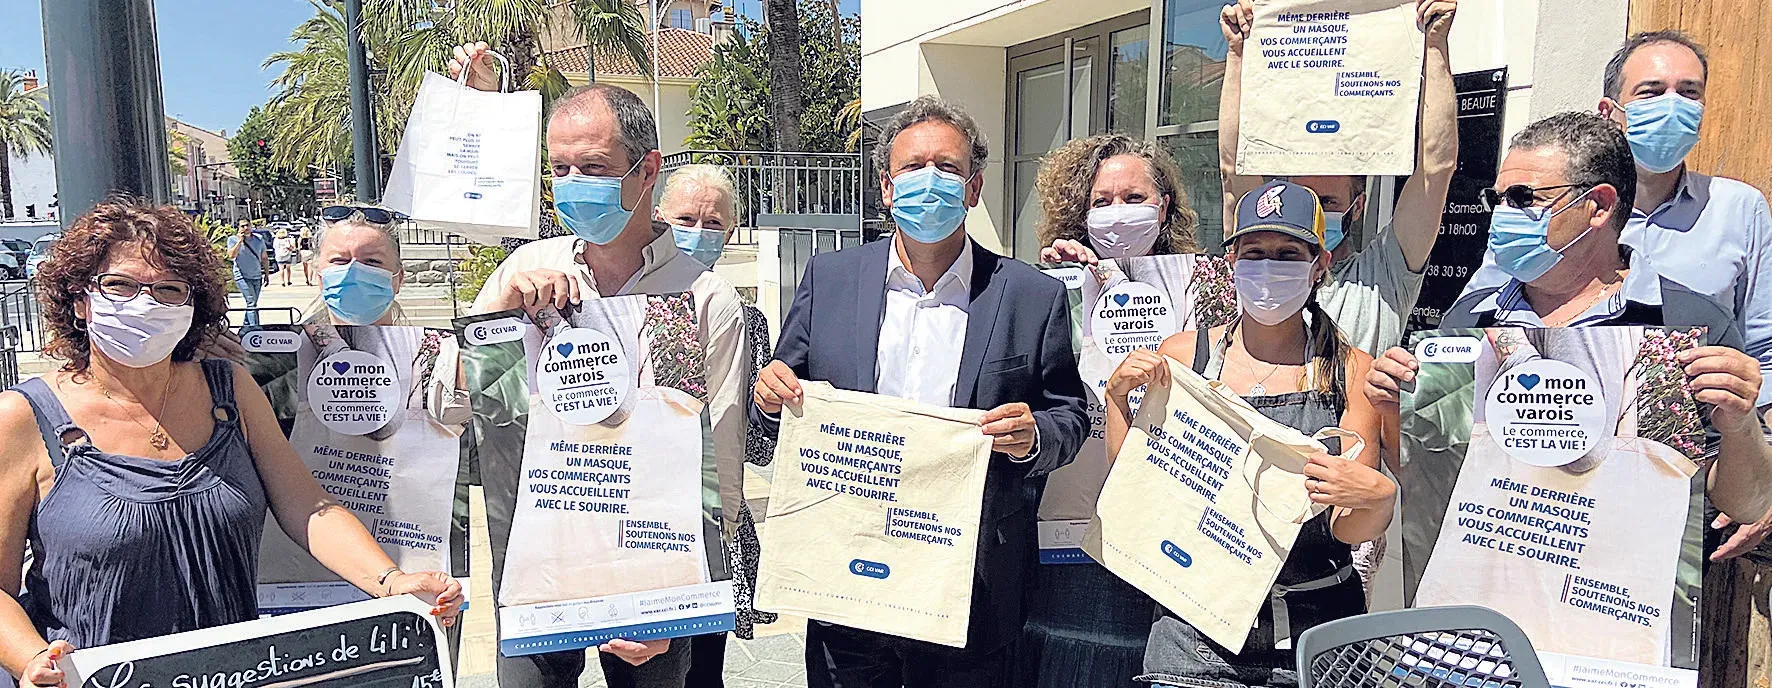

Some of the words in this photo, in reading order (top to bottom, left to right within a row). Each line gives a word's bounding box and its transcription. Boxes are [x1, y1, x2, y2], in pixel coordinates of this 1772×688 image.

[1277, 12, 1304, 22] MÊME
[1306, 10, 1350, 22] DERRIÈRE
[1293, 25, 1306, 34] UN
[1308, 23, 1349, 34] MASQUE,
[1260, 37, 1278, 46] VOS
[1279, 35, 1348, 47] COMMERÇANTS
[1262, 49, 1286, 58] VOUS
[1287, 47, 1347, 57] ACCUEILLENT
[1267, 61, 1289, 69] AVEC
[1290, 60, 1301, 69] LE
[1303, 59, 1345, 68] SOURIRE.
[1341, 71, 1381, 79] ENSEMBLE,
[1340, 80, 1384, 88] SOUTENONS
[1385, 79, 1401, 87] NOS
[1339, 89, 1395, 98] COMMERÇANTS.
[1461, 95, 1497, 111] BEAUTE
[1448, 223, 1477, 235] 18h00
[1427, 265, 1439, 276] 38
[1441, 265, 1454, 277] 30
[1455, 266, 1468, 278] 39
[1133, 295, 1161, 305] mon
[1099, 306, 1167, 319] commerce
[491, 327, 503, 335] CCI
[504, 325, 518, 333] VAR
[1113, 317, 1154, 331] varois
[577, 341, 610, 355] mon
[1104, 336, 1116, 345] Le
[354, 364, 385, 374] mon
[544, 353, 618, 373] commerce
[316, 376, 392, 386] commerce
[560, 367, 605, 386] varois
[1545, 377, 1586, 390] mon
[331, 388, 377, 399] varois
[552, 393, 563, 402] Le
[565, 387, 618, 401] commerce,
[1496, 391, 1594, 405] commerce
[321, 404, 332, 412] Le
[335, 404, 388, 413] commerce,
[555, 402, 580, 413] C'EST
[583, 399, 595, 409] LA
[596, 398, 613, 407] VIE
[1515, 405, 1574, 421] varois
[323, 413, 350, 421] C'EST
[352, 413, 366, 421] LA
[367, 413, 381, 421] VIE
[819, 423, 851, 438] MÊME
[853, 429, 906, 446] DERRIÈRE
[1173, 409, 1197, 430] MÊME
[1198, 424, 1243, 456] DERRIÈRE
[1503, 426, 1516, 436] Le
[1520, 427, 1588, 440] commerce,
[550, 440, 579, 453] MÊME
[581, 443, 633, 456] DERRIÈRE
[837, 441, 852, 453] UN
[854, 444, 903, 462] MASQUE,
[1182, 430, 1196, 444] UN
[1195, 438, 1233, 469] MASQUE,
[1504, 437, 1539, 449] C'EST
[1541, 439, 1557, 449] LA
[1559, 440, 1579, 450] VIE
[313, 445, 344, 458] MÊME
[345, 451, 395, 467] DERRIÈRE
[1148, 424, 1168, 440] VOS
[1167, 435, 1230, 481] COMMERÇANTS
[566, 457, 581, 467] UN
[583, 458, 632, 471] MASQUE,
[799, 447, 821, 460] VOS
[822, 452, 901, 475] COMMERÇANTS
[1146, 438, 1171, 457] VOUS
[1170, 452, 1225, 492] ACCUEILLENT
[328, 460, 345, 470] UN
[345, 463, 392, 479] MASQUE,
[528, 469, 549, 479] VOS
[550, 470, 631, 485] COMMERÇANTS
[800, 462, 830, 476] VOUS
[831, 468, 901, 488] ACCUEILLENT
[311, 469, 390, 490] COMMERÇANTS
[1146, 453, 1170, 472] AVEC
[1168, 468, 1179, 479] LE
[1179, 474, 1217, 505] SOURIRE.
[529, 483, 558, 495] VOUS
[559, 485, 631, 499] ACCUEILLENT
[806, 477, 833, 491] AVEC
[834, 482, 847, 493] LE
[848, 485, 898, 503] SOURIRE.
[1490, 477, 1529, 495] MÊME
[1530, 486, 1596, 509] DERRIÈRE
[338, 499, 385, 515] OURIRE.
[535, 499, 561, 510] AVEC
[563, 500, 576, 511] LE
[578, 501, 630, 514] SOURIRE.
[1509, 496, 1529, 510] UN
[1530, 501, 1592, 525] MASQUE,
[893, 507, 939, 523] ENSEMBLE,
[1208, 508, 1245, 538] ENSEMBLE,
[1458, 501, 1485, 515] VOS
[1486, 507, 1589, 539] COMMERÇANTS
[379, 519, 421, 532] ENSEMBLE,
[626, 519, 671, 531] ENSEMBLE,
[891, 518, 943, 533] SOUTENONS
[944, 527, 962, 537] NOS
[376, 536, 437, 551] COMMERÇANTS.
[378, 527, 426, 540] SOUTENONS
[427, 535, 443, 544] NOS
[625, 530, 677, 541] SOUTENONS
[678, 533, 696, 543] NOS
[890, 529, 954, 547] COMMERÇANTS.
[1205, 518, 1247, 549] SOUTENONS
[1246, 545, 1263, 559] NOS
[1458, 517, 1494, 533] VOUS
[1495, 525, 1586, 554] ACCUEILLENT
[625, 540, 692, 553] COMMERÇANTS.
[1201, 527, 1252, 566] COMMERÇANTS.
[1462, 533, 1497, 550] AVEC
[1498, 540, 1514, 554] LE
[1516, 545, 1581, 570] SOURIRE.
[1573, 575, 1631, 599] ENSEMBLE,
[1571, 586, 1636, 610] SOUTENONS
[1637, 603, 1661, 618] NOS
[1569, 597, 1652, 628] COMMERÇANTS.
[331, 633, 360, 662] de
[514, 640, 553, 650] CHAMBRE
[573, 634, 614, 643] COMMERCE
